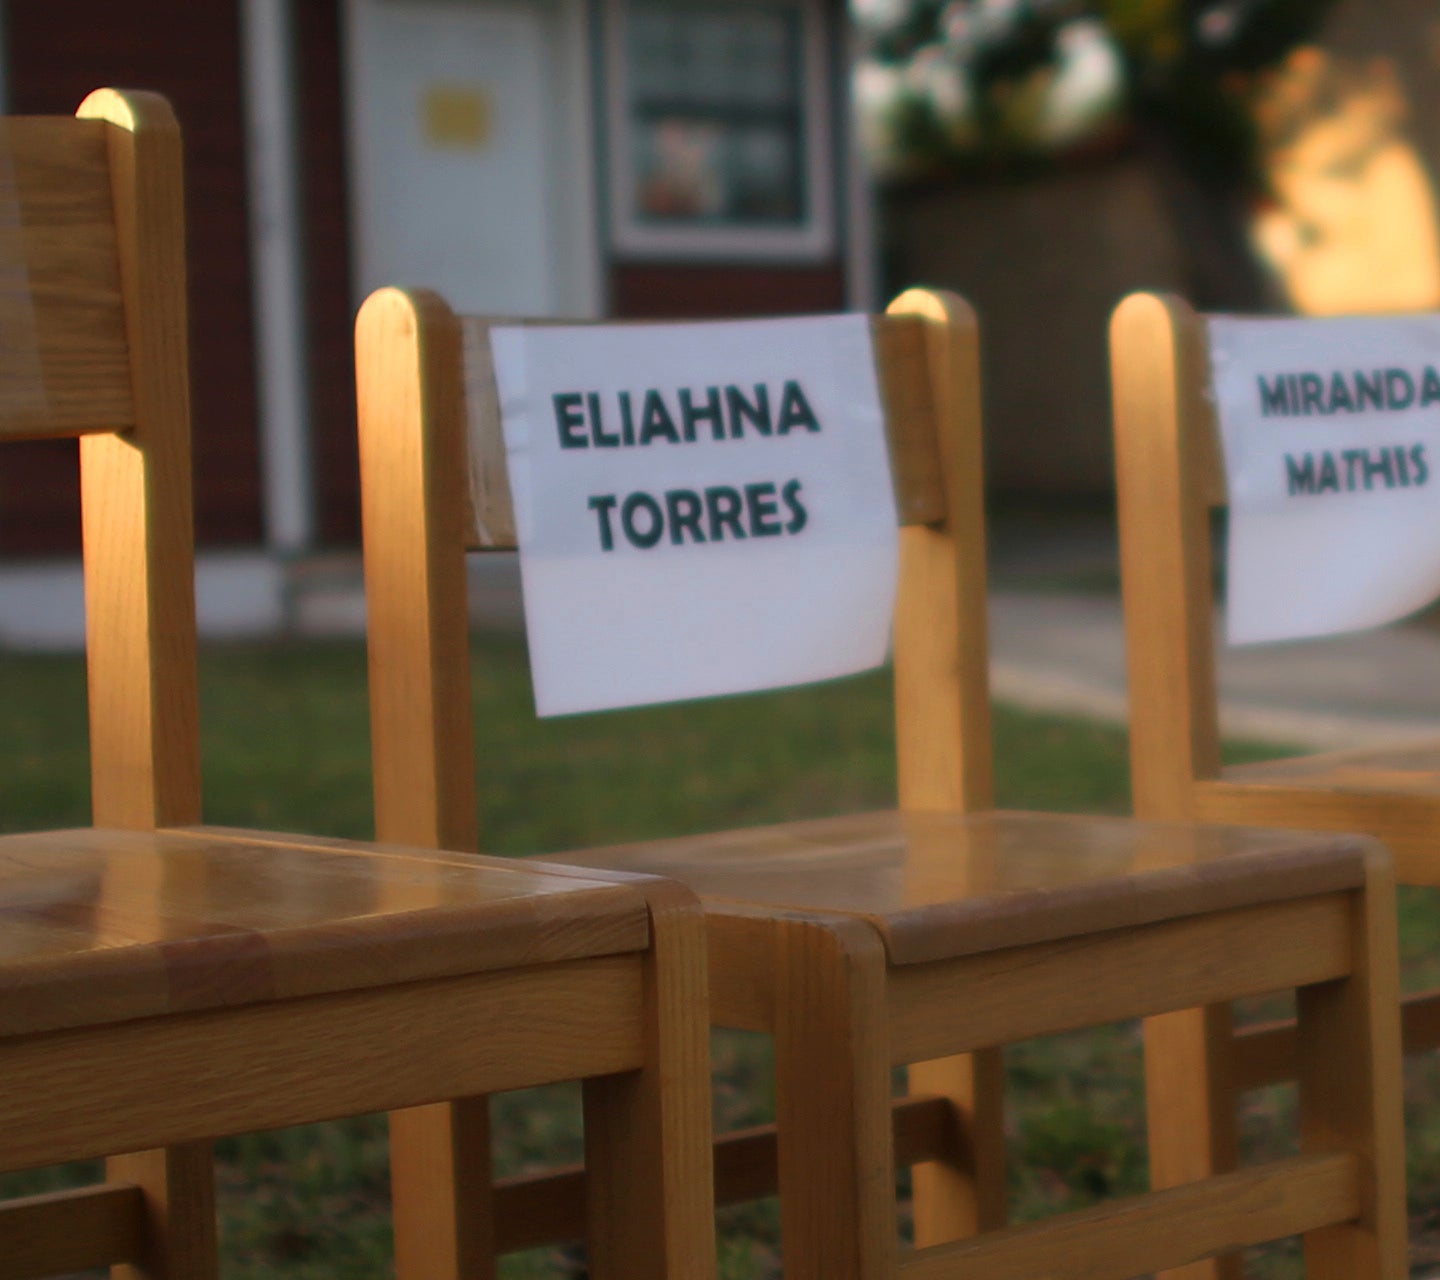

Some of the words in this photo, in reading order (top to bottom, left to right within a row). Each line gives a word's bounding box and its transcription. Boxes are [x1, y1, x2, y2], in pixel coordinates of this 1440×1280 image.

[551, 379, 821, 450] ELIAHNA
[1284, 442, 1430, 496] MATHIS
[587, 478, 808, 552] TORRES
